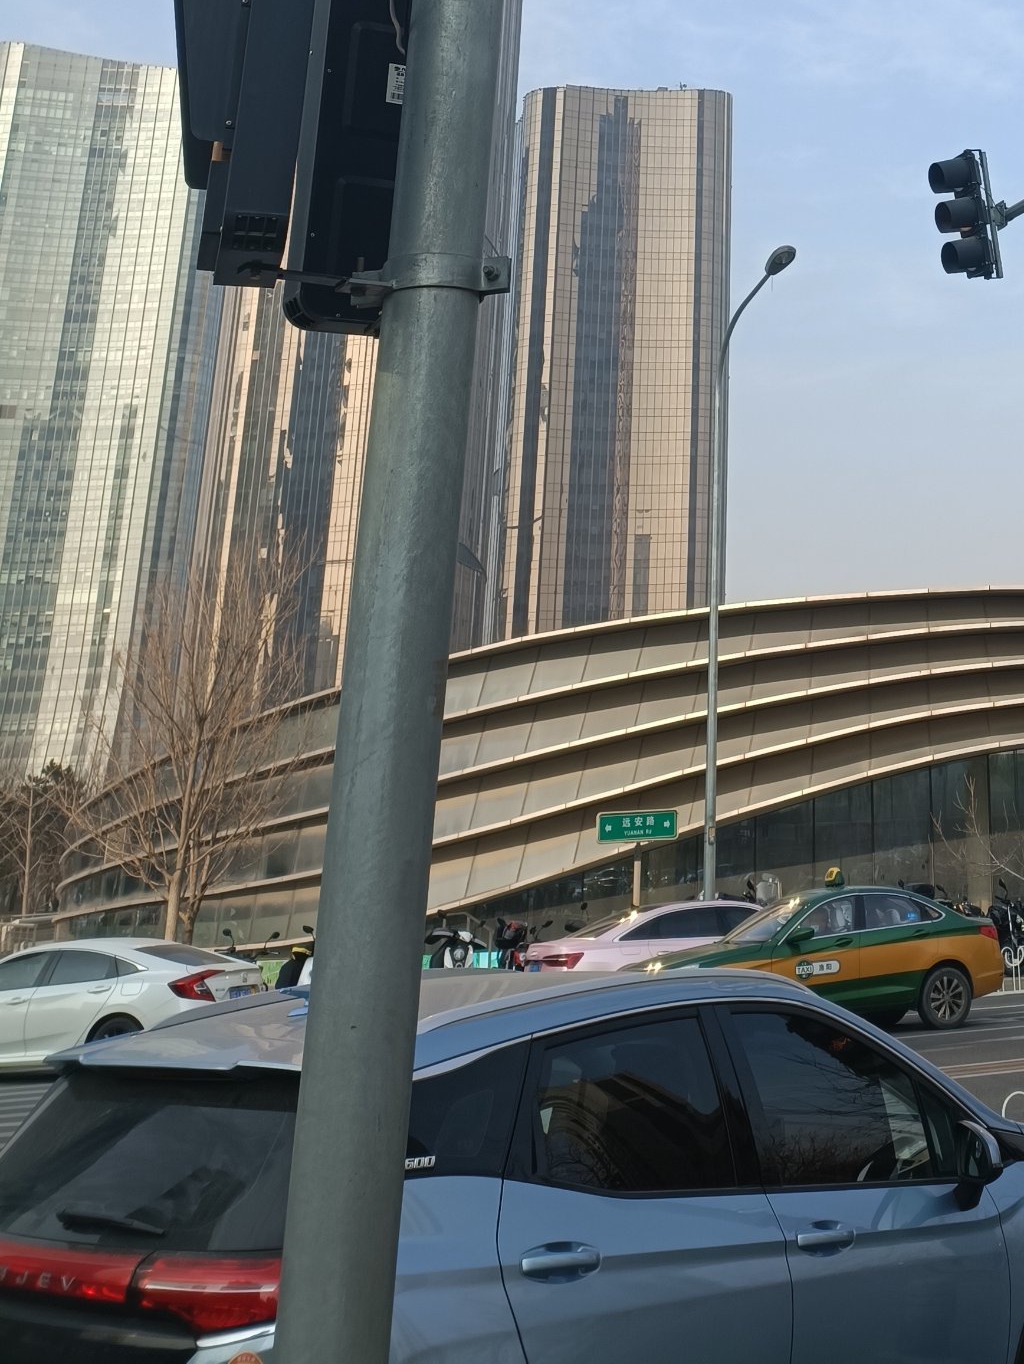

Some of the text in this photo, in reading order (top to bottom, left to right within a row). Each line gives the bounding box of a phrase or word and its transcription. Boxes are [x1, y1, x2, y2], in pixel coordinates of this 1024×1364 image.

[622, 816, 655, 828] 远安路
[624, 829, 644, 837] YUANAN
[797, 964, 813, 974] TAXI
